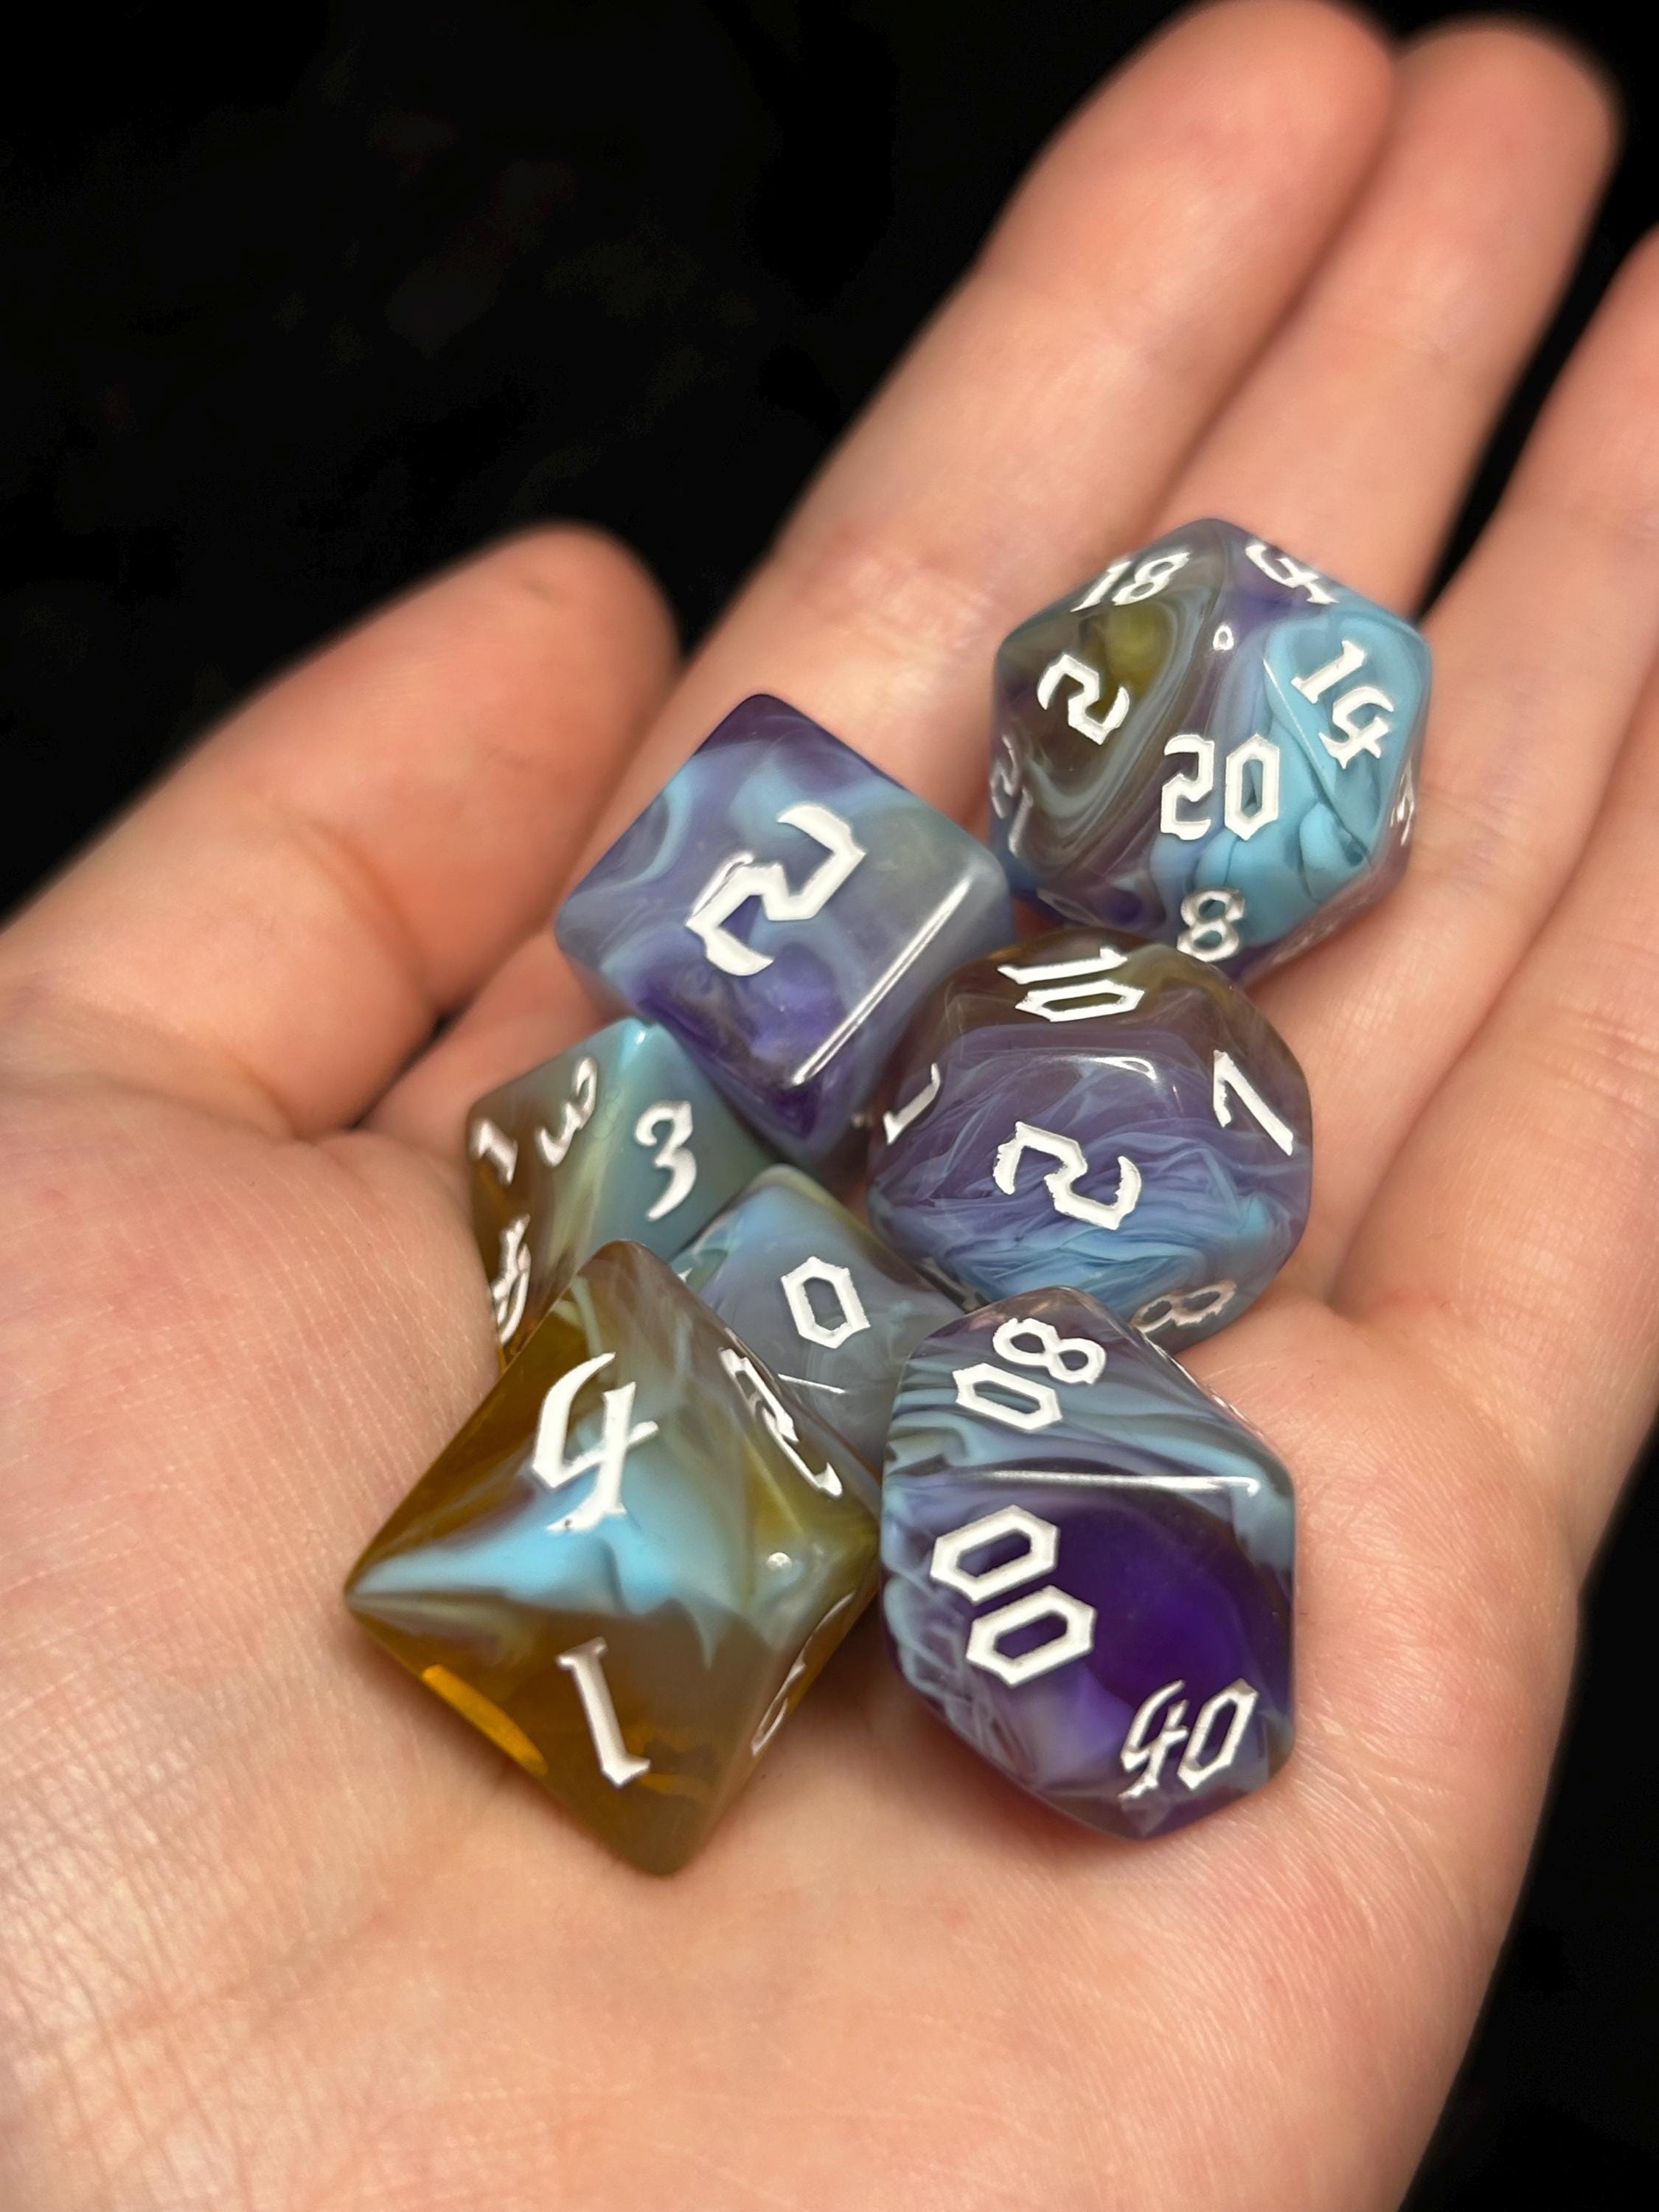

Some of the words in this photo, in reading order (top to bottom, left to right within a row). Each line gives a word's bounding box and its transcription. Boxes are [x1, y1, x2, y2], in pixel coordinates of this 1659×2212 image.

[1071, 552, 1192, 611] 18
[1245, 544, 1338, 603] 4
[1037, 654, 1130, 745] 2
[1292, 639, 1395, 768] 14
[1161, 732, 1280, 839] 20
[686, 801, 866, 975] 2
[1177, 888, 1246, 961] 8
[998, 947, 1144, 1022] 10
[1213, 1050, 1294, 1156] 7
[635, 1100, 698, 1222] 3
[994, 1121, 1142, 1231] 2
[780, 1256, 872, 1349] 0
[531, 1352, 661, 1534] 4
[930, 1505, 1098, 1688] 00
[555, 1636, 650, 1789] 1
[1118, 1678, 1259, 1799] 40
